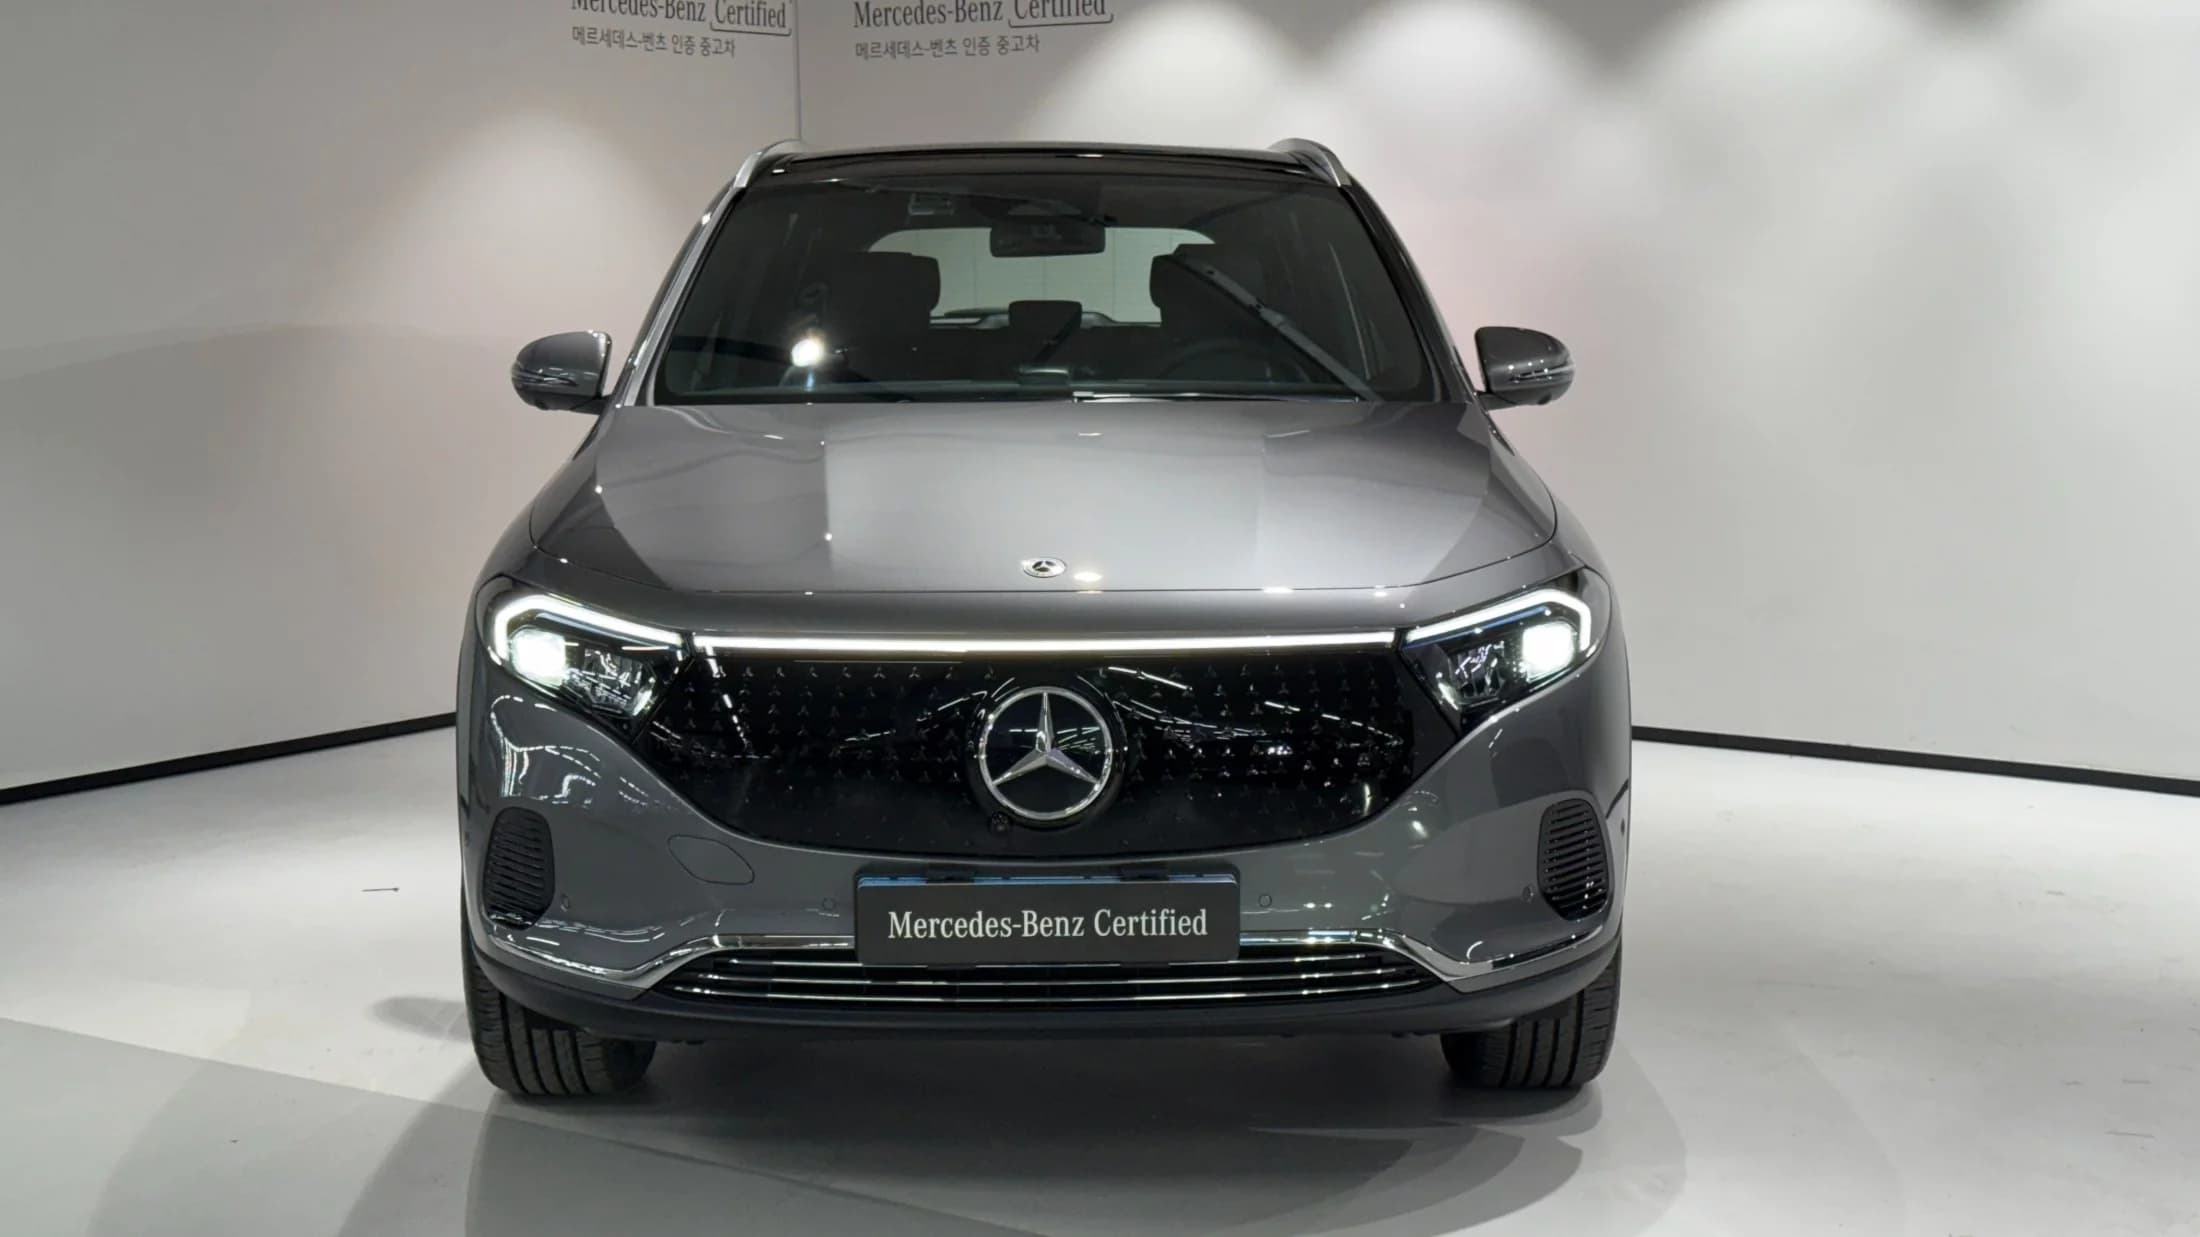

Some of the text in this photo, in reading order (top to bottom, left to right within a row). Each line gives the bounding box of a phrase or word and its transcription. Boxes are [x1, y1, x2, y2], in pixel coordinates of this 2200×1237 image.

[714, 0, 786, 28] Certified
[854, 0, 1106, 28] Mercedes-Benz Certified
[572, 26, 736, 57] 메르세데스-벤츠 인증 중고차
[855, 34, 1040, 60] 메르세데스-벤츠 인증 중고차
[888, 908, 1208, 939] Mercedes-Benz Certified
